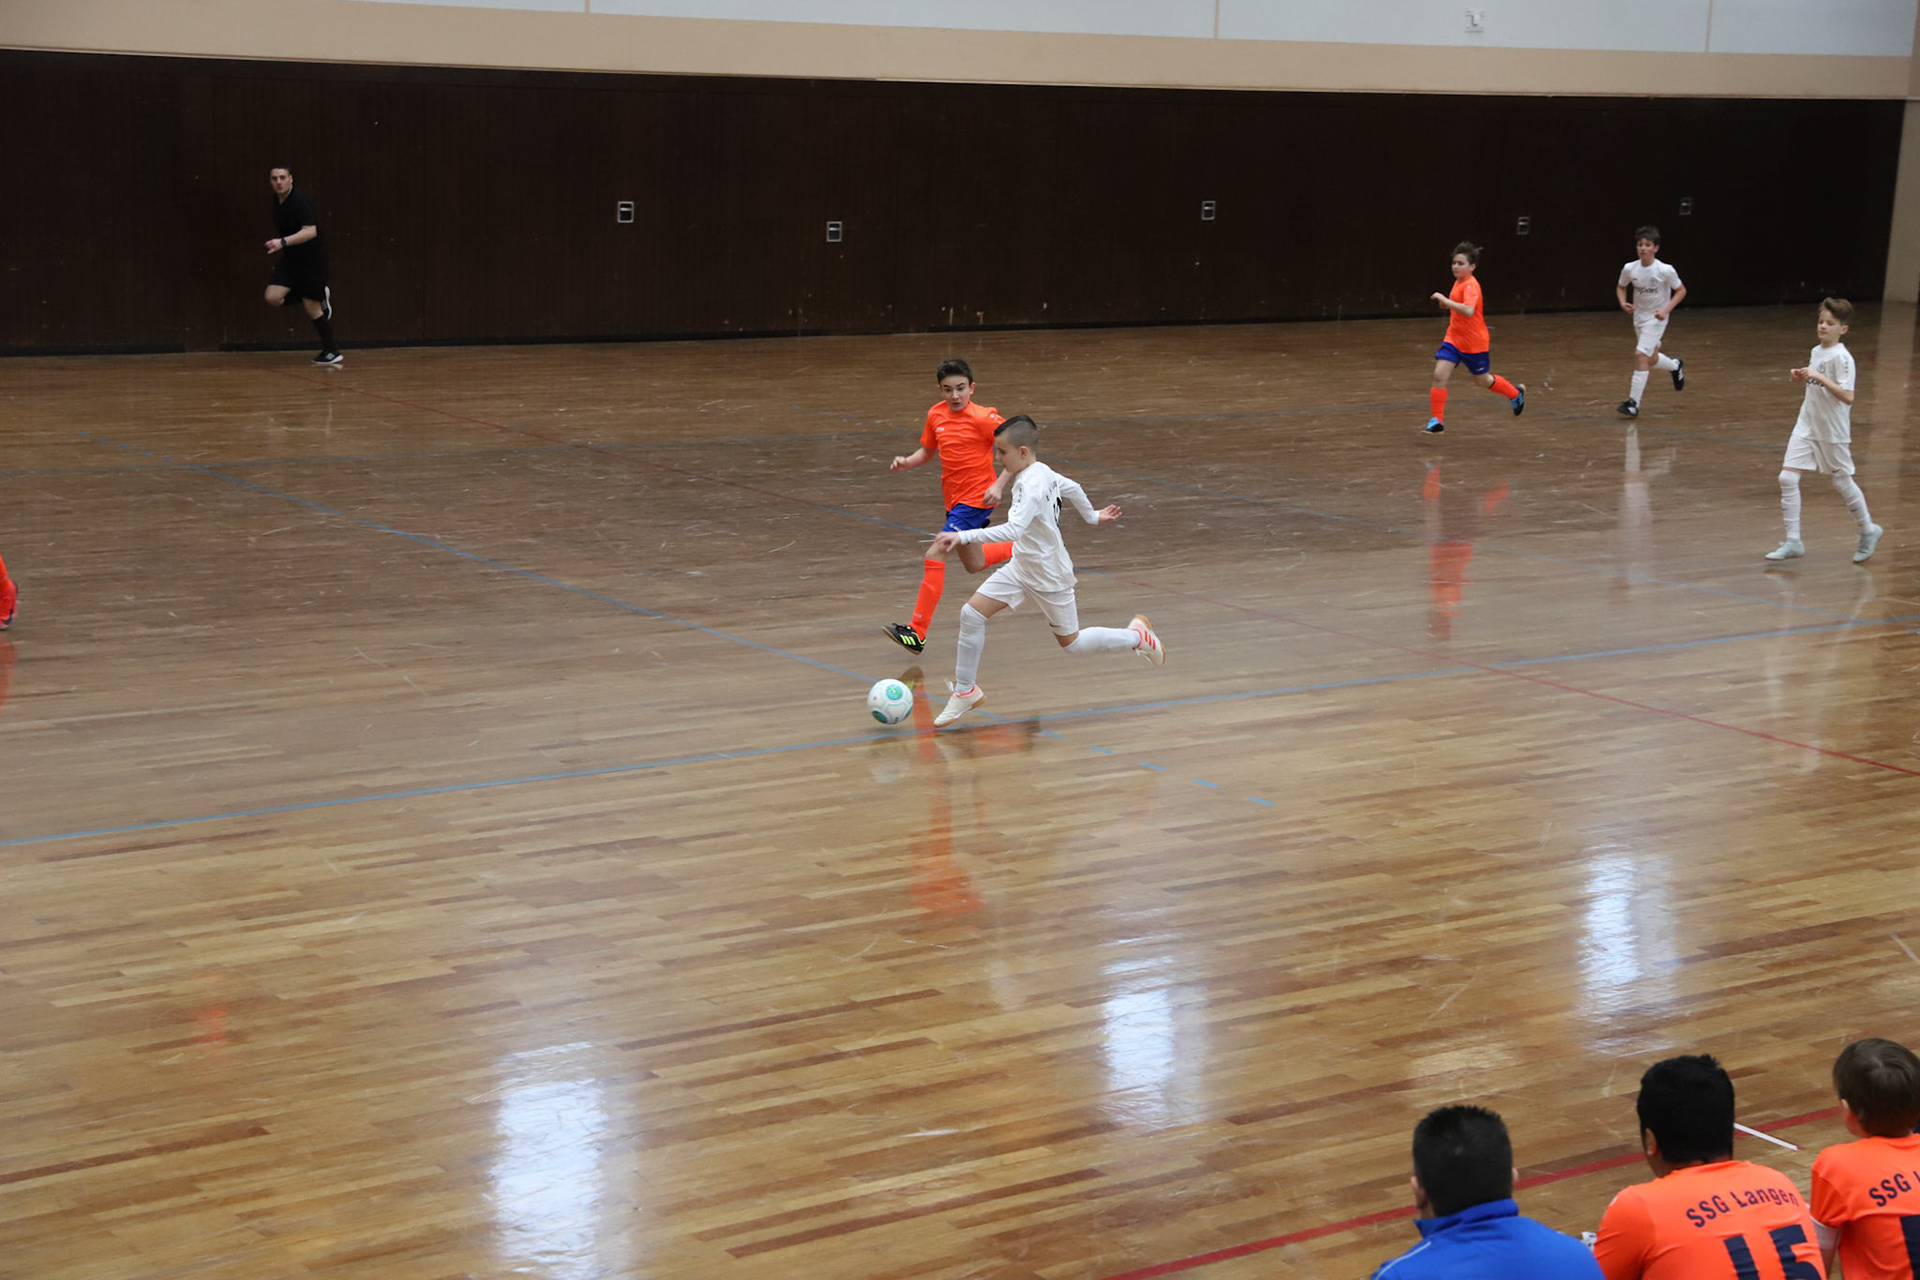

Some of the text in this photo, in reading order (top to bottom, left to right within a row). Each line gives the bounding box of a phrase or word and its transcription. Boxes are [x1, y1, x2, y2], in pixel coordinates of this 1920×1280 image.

[1686, 1188, 1800, 1228] SSG Langen
[1869, 1173, 1912, 1207] SSG
[1723, 1224, 1822, 1280] 15
